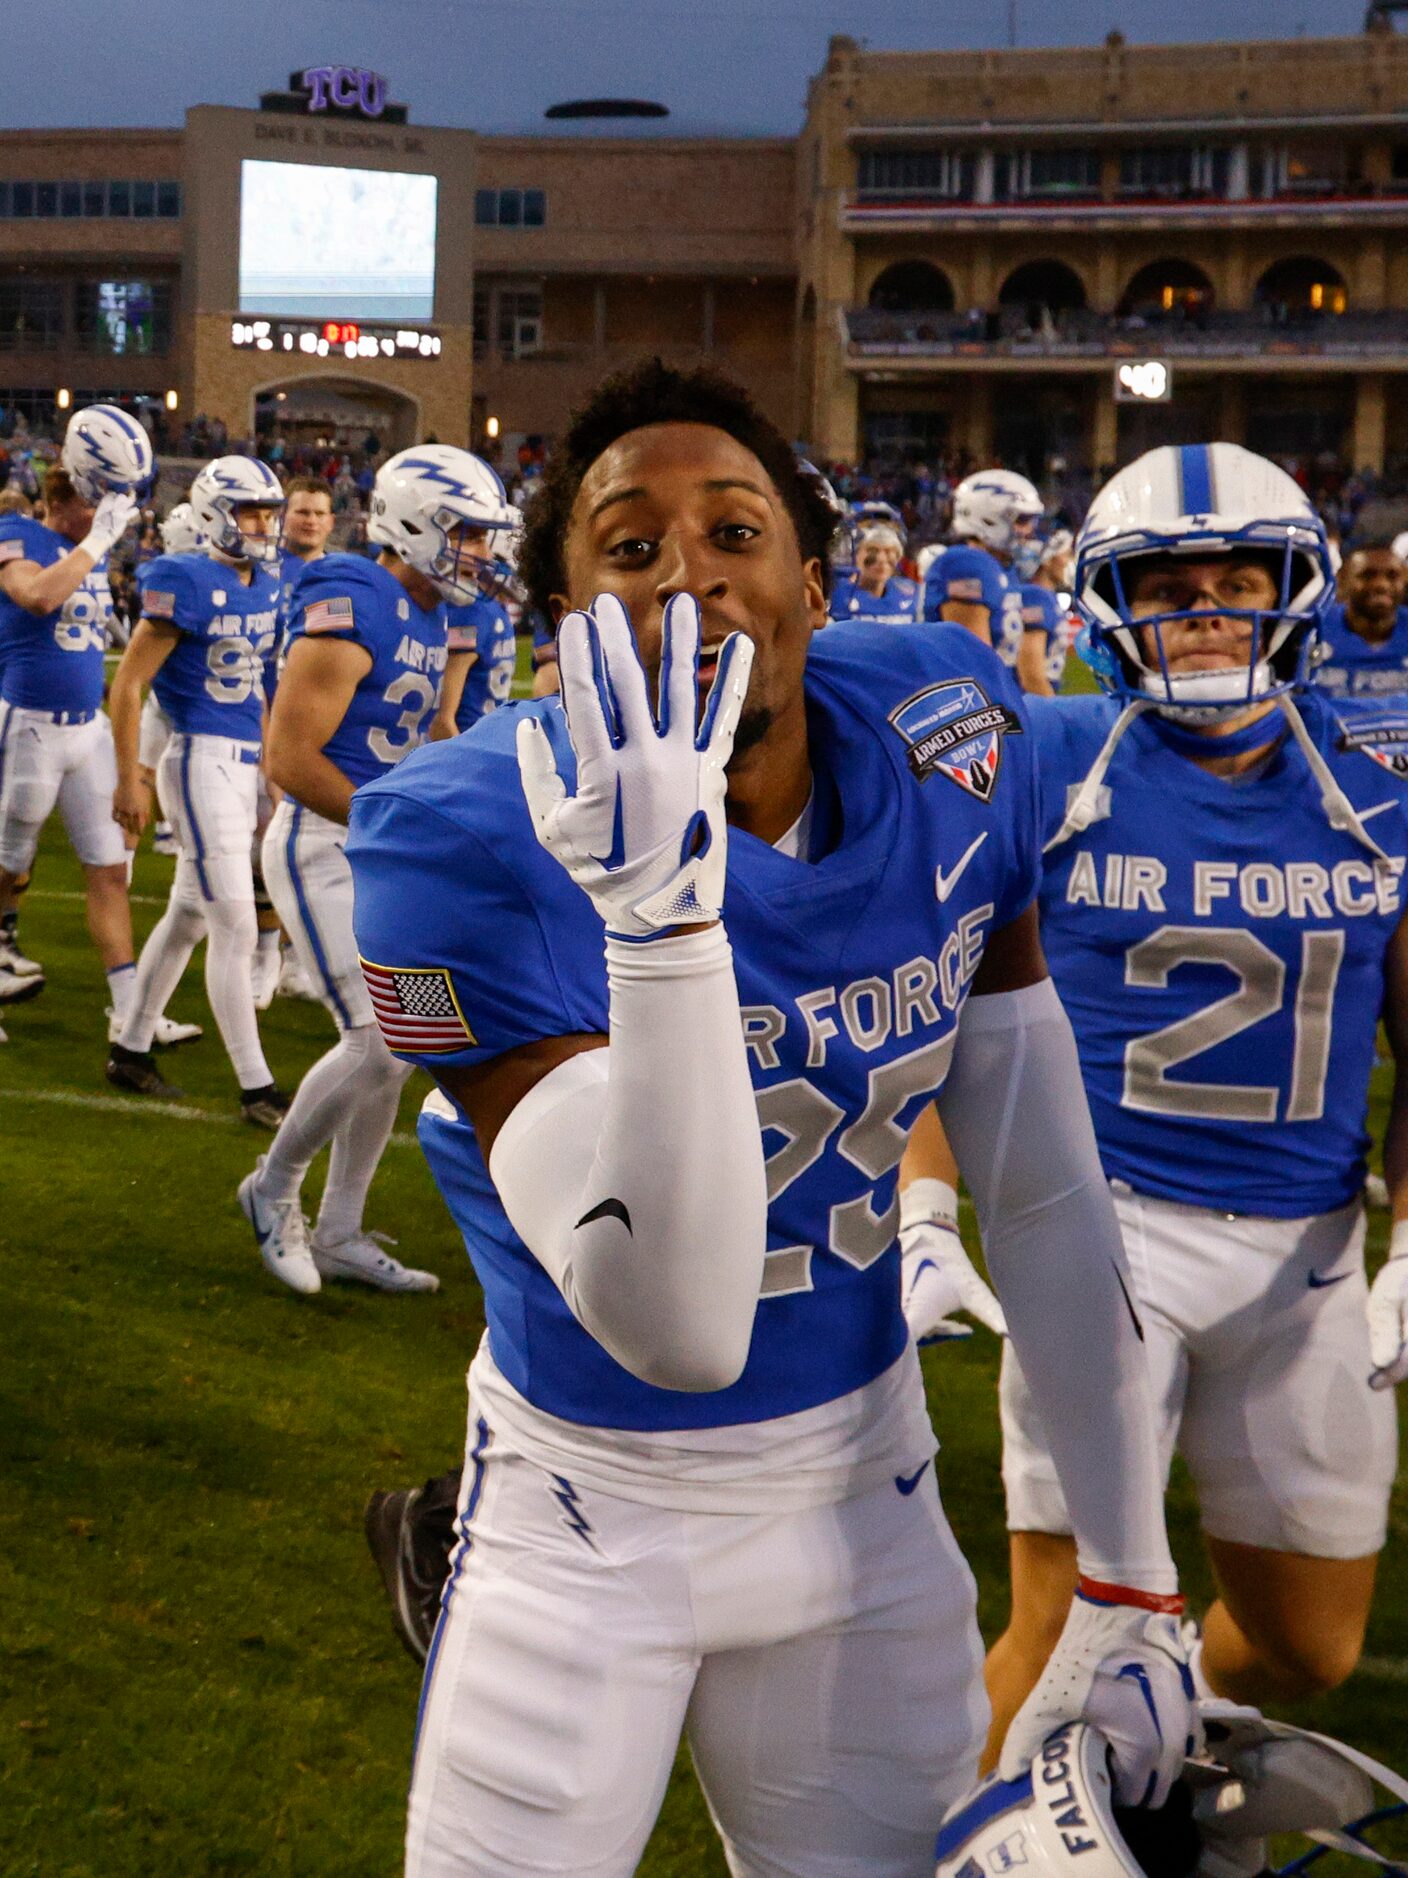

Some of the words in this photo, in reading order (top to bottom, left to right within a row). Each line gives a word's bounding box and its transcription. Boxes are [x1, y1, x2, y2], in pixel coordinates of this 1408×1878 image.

[304, 66, 387, 116] TCU
[207, 614, 243, 636] AIR
[394, 634, 426, 672] AIR
[367, 670, 445, 764] 3
[913, 729, 957, 765] ARMED
[953, 709, 1006, 739] FORCES
[950, 740, 987, 764] BOWL
[1066, 850, 1168, 913] AIR
[1193, 856, 1407, 919] FORCE
[794, 902, 995, 1069] FORCE
[1119, 924, 1346, 1123] 21
[754, 1027, 959, 1301] 25
